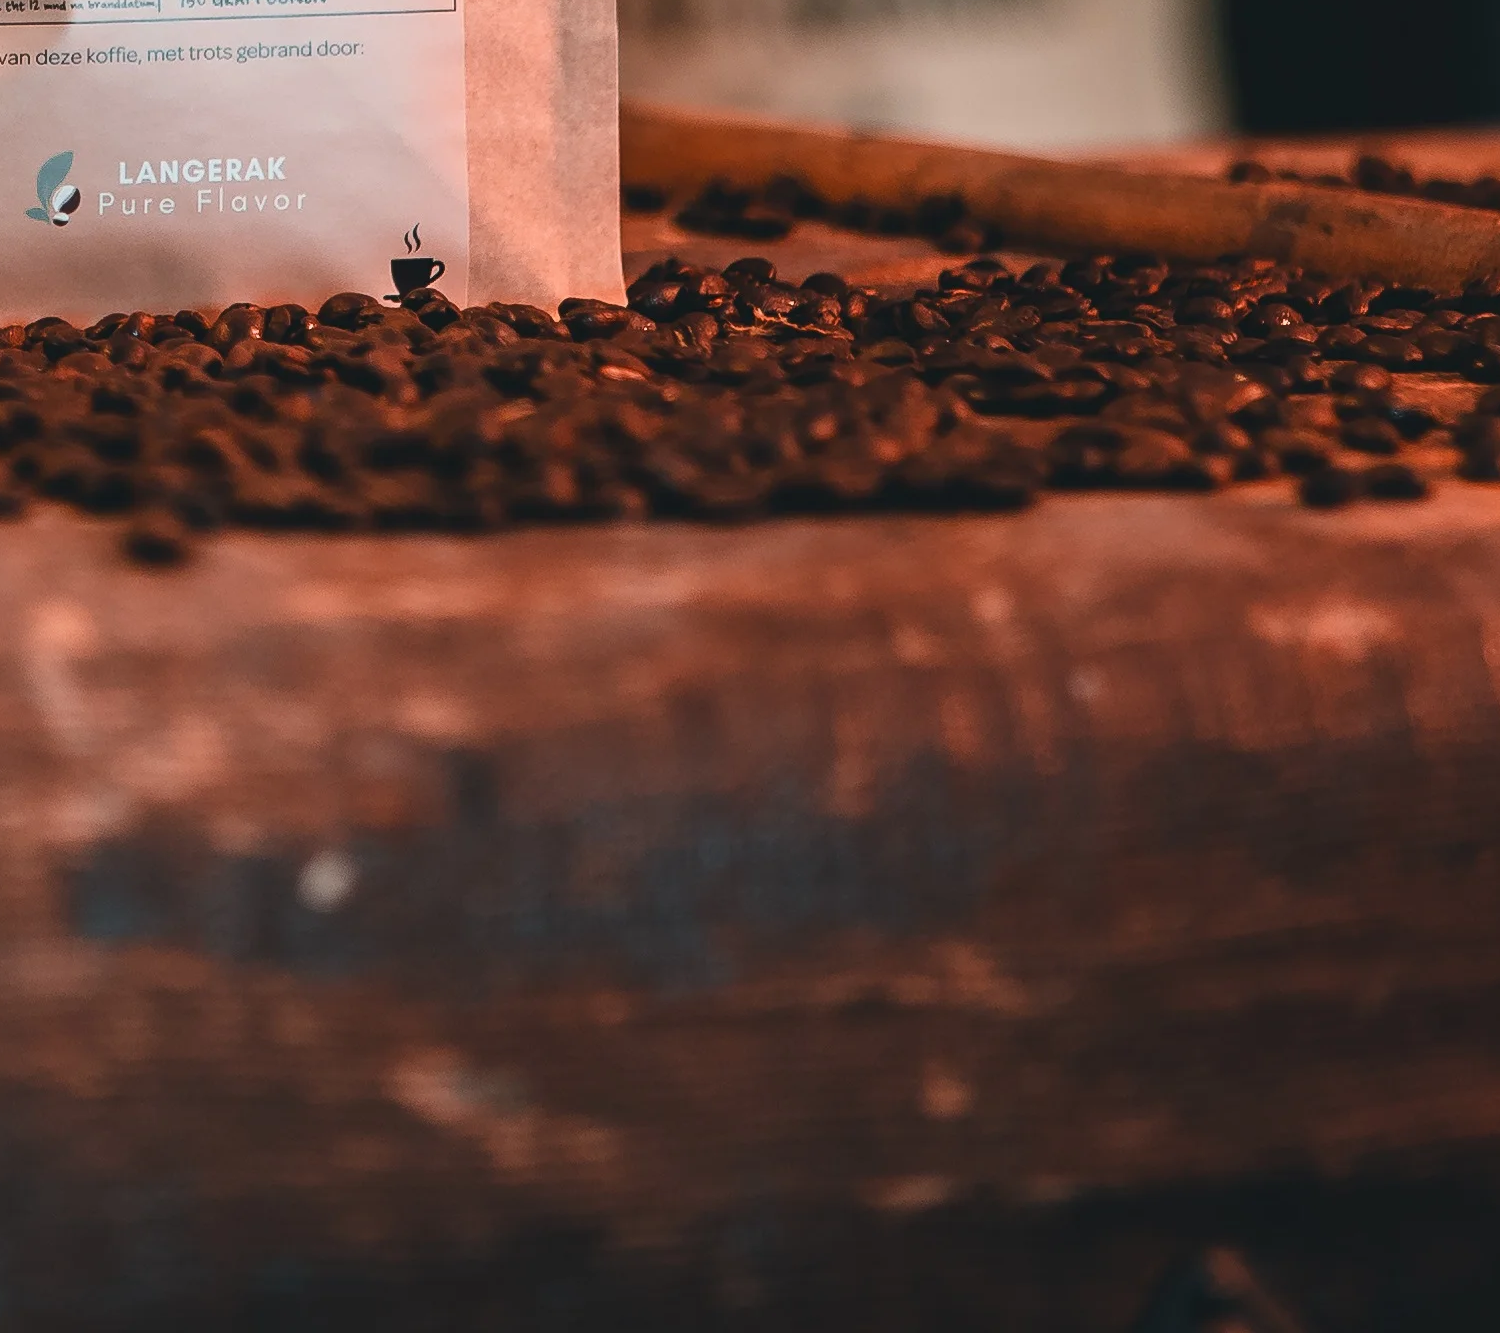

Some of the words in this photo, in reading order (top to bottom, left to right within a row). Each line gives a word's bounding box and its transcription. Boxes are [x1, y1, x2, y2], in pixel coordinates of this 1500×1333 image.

[5, 0, 25, 12] tht
[29, 0, 40, 10] 12
[43, 0, 66, 11] mnd
[70, 1, 83, 10] na
[35, 48, 82, 66] deze
[86, 46, 142, 66] koffie,
[146, 47, 185, 63] met
[189, 44, 232, 61] trots
[236, 41, 312, 63] gebrand
[316, 39, 364, 58] door:
[118, 156, 286, 185] LANGERAK
[98, 191, 176, 215] Pure
[196, 186, 307, 213] Flavor
